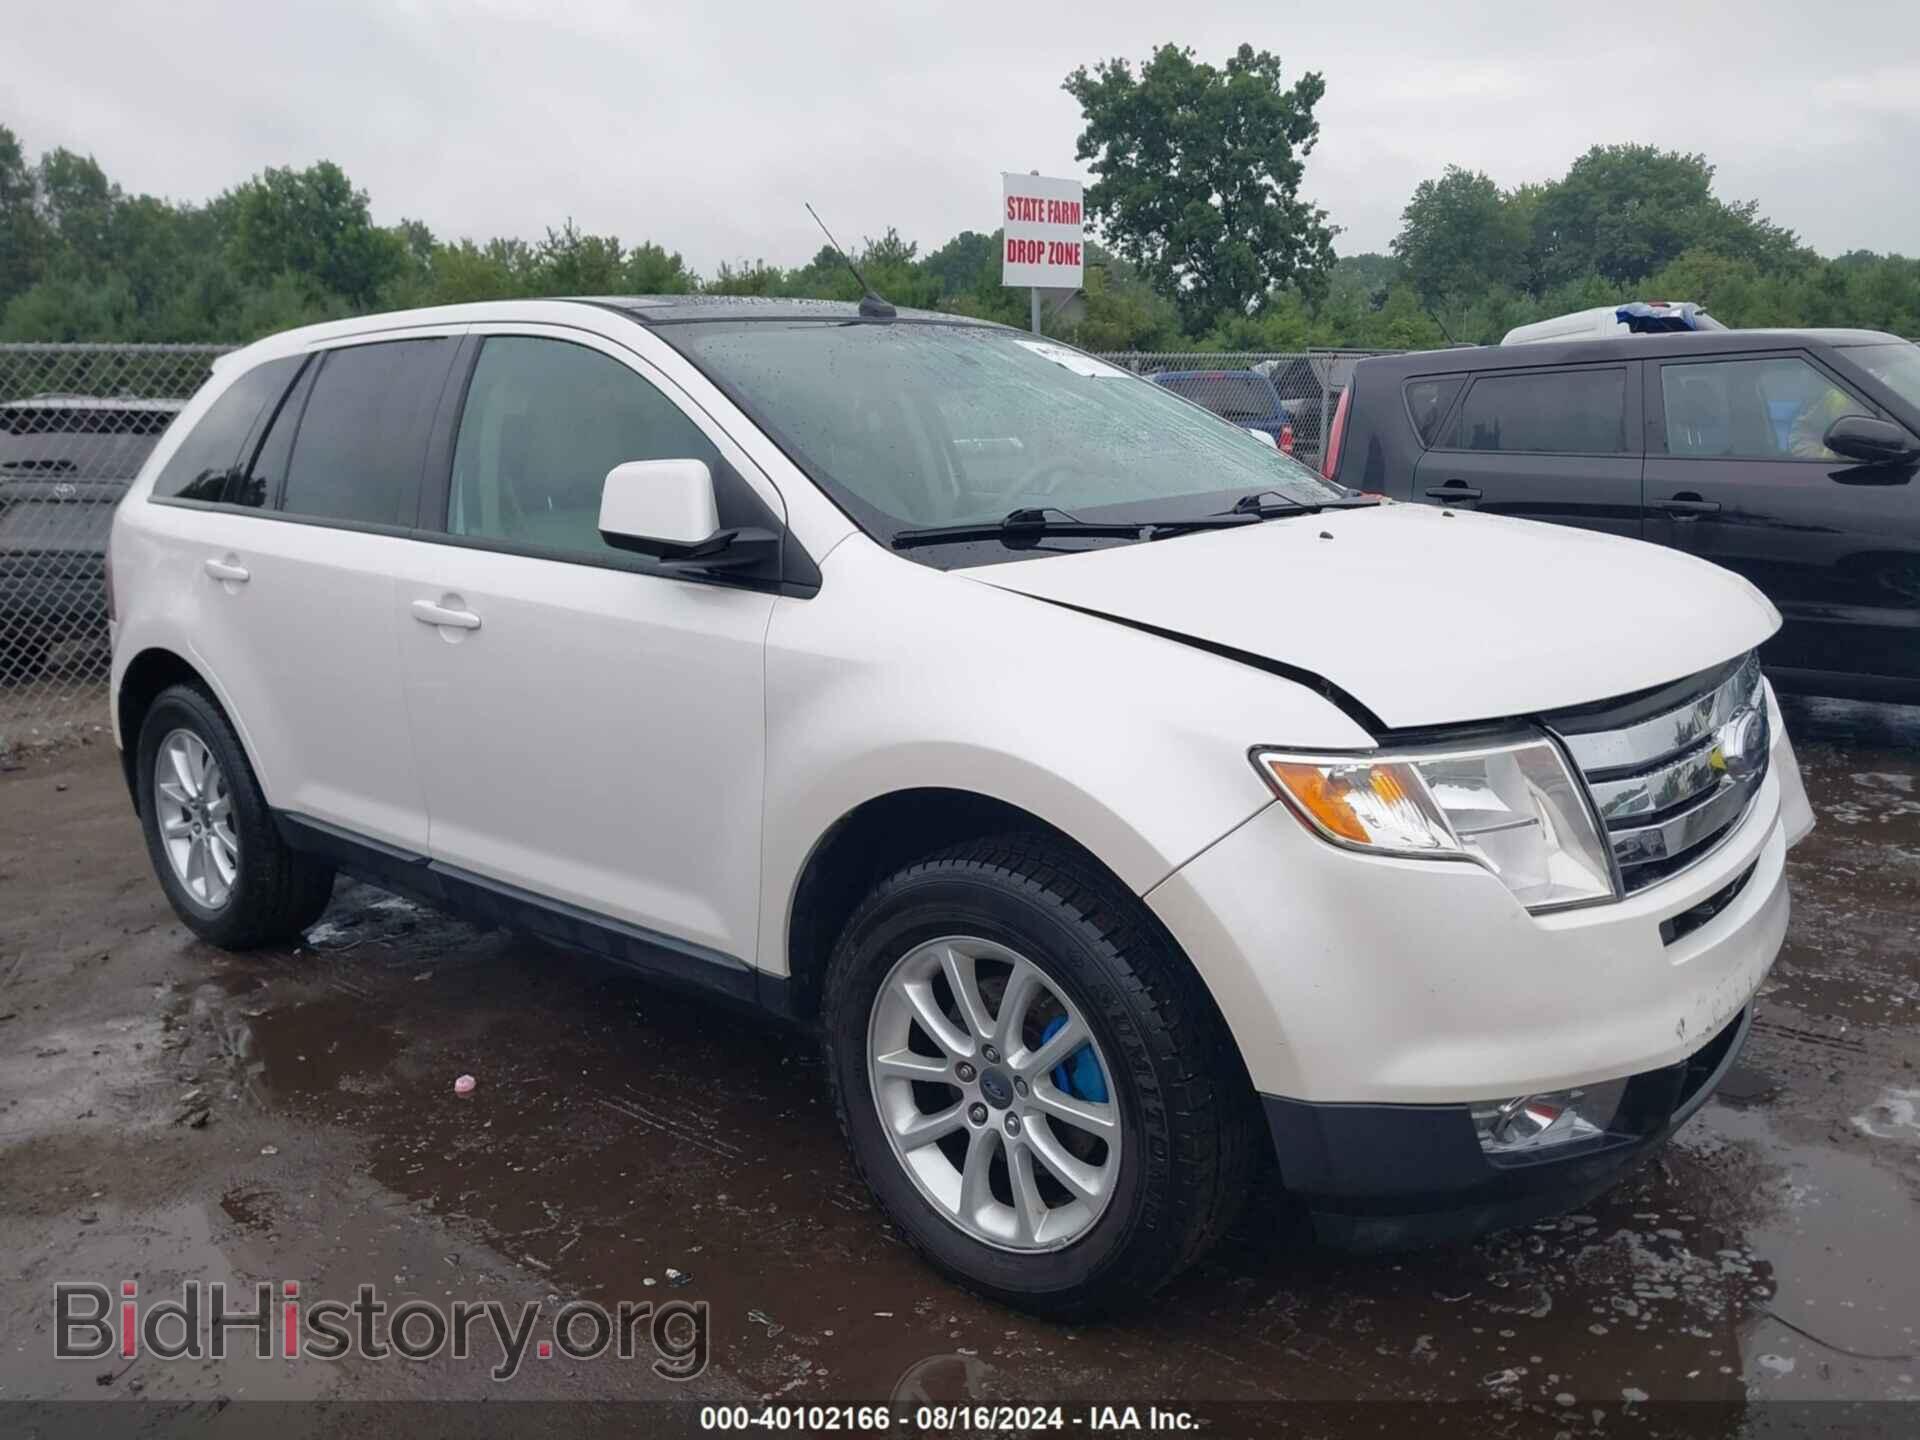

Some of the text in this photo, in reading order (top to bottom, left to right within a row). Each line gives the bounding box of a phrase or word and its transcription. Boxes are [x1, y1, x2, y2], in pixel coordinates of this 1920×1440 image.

[1007, 196, 1081, 225] STATE FARM
[1007, 239, 1081, 266] DROP ZONE
